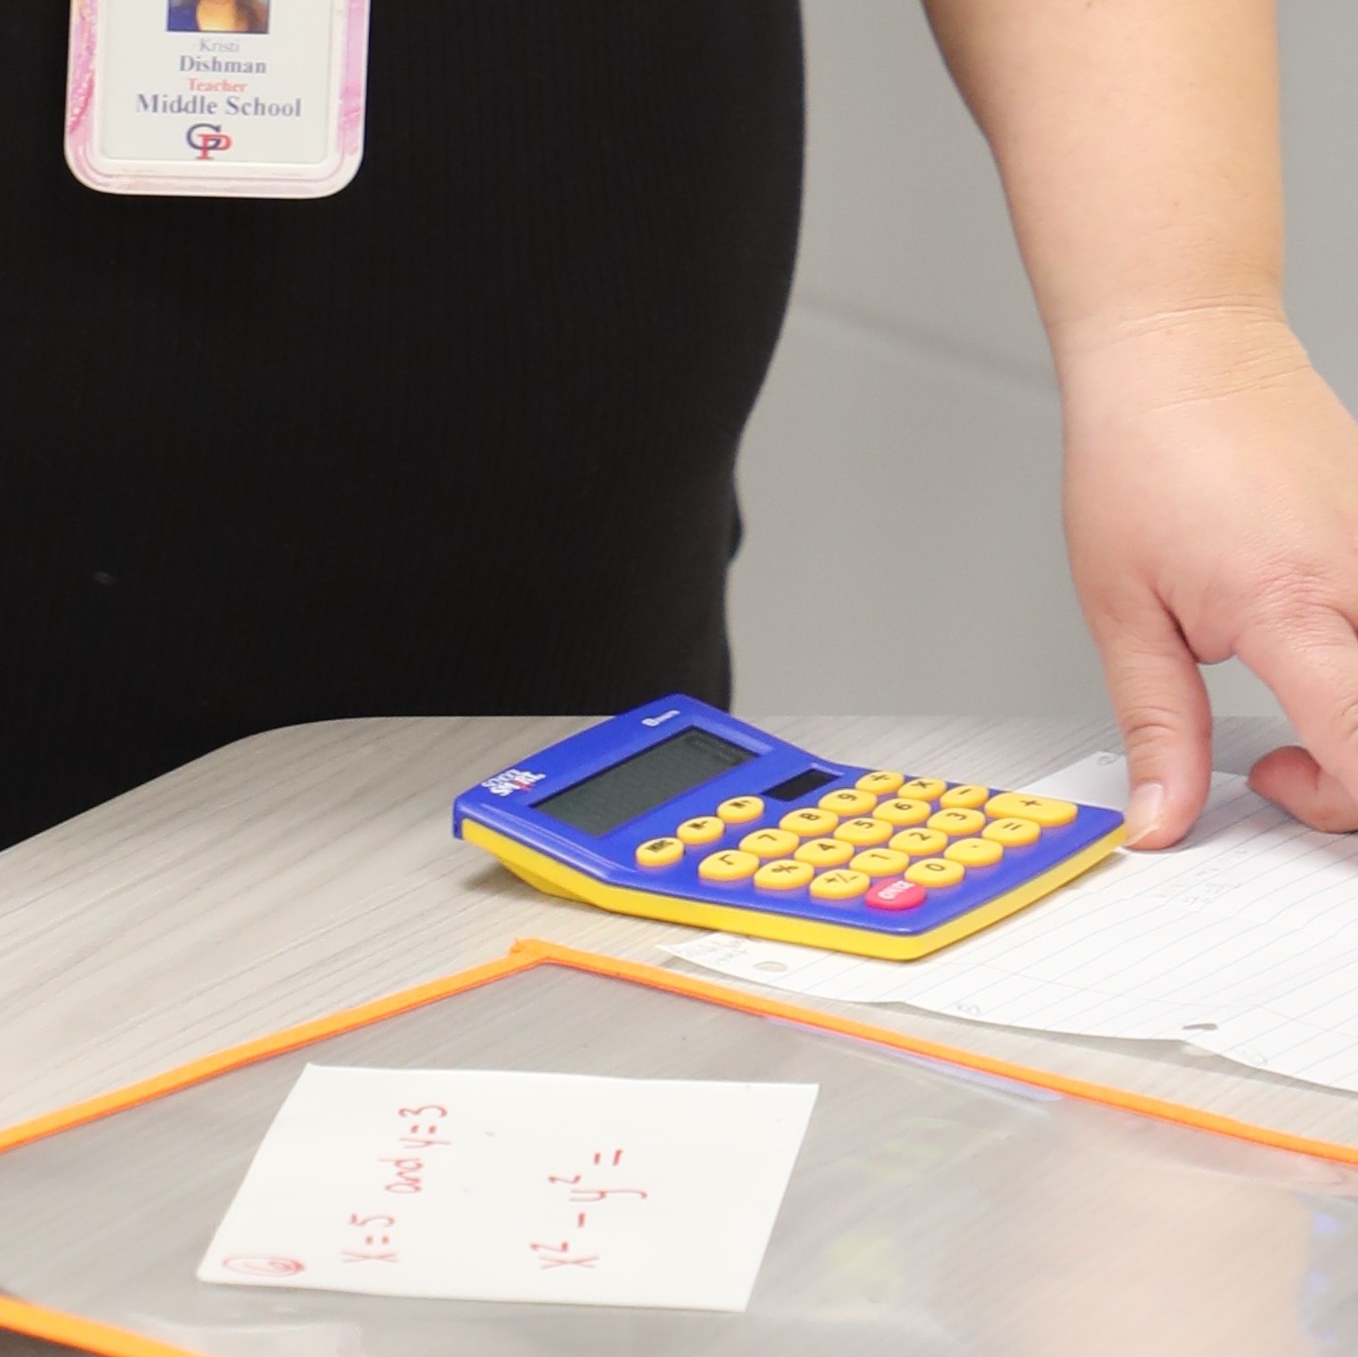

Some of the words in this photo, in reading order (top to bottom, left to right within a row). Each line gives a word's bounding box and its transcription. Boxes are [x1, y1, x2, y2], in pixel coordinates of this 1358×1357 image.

[179, 55, 267, 73] Dishman
[188, 77, 248, 93] Teacher
[136, 93, 219, 115] Middle
[225, 95, 302, 117] School
